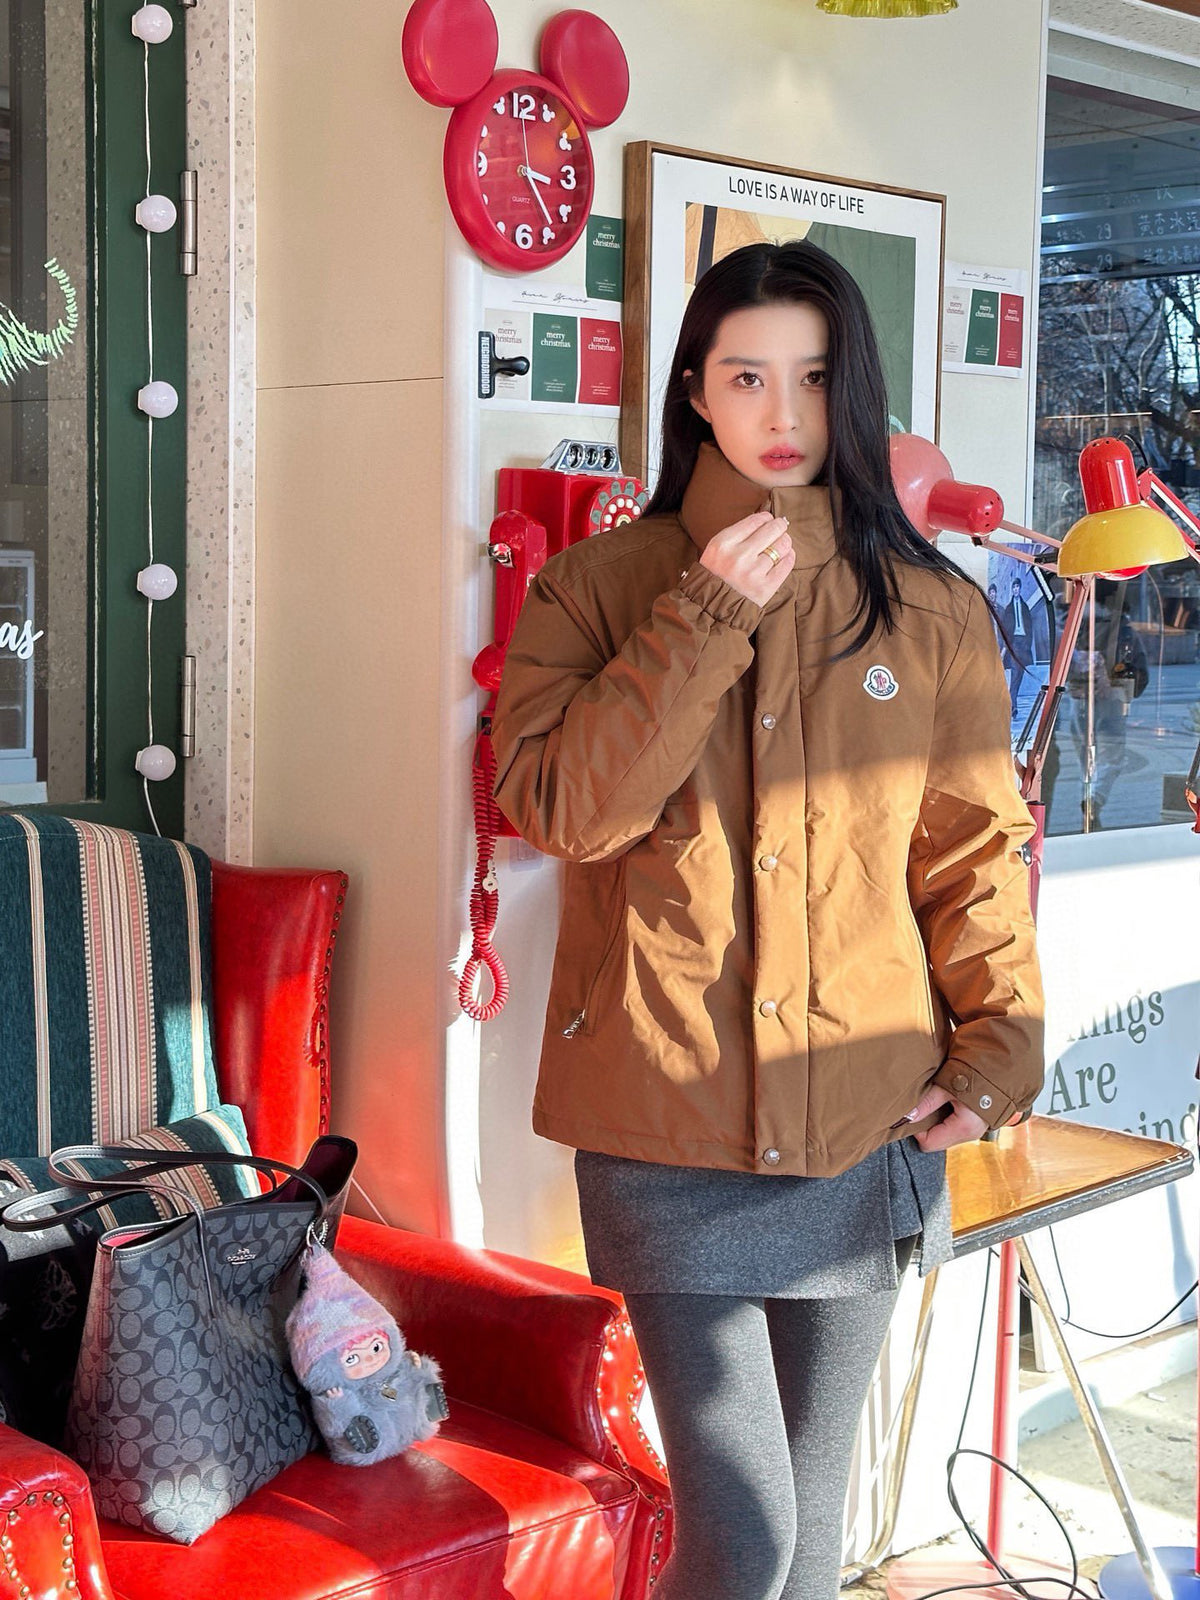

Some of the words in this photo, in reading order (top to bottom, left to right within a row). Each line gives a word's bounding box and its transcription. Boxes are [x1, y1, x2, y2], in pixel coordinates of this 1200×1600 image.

[512, 92, 536, 121] 12
[560, 165, 577, 190] 3
[729, 176, 762, 198] LOVE
[765, 183, 778, 200] IS
[780, 186, 789, 202] A
[790, 187, 818, 206] WAY
[820, 192, 836, 208] OF
[839, 195, 865, 214] LIFE
[515, 223, 533, 250] 6
[597, 232, 616, 243] merry
[497, 328, 517, 337] merry
[546, 331, 566, 342] merry
[495, 334, 522, 344] hristmas
[540, 338, 571, 348] christmas
[592, 335, 611, 346] merry
[587, 343, 616, 353] christmas
[1046, 1058, 1118, 1116] Are
